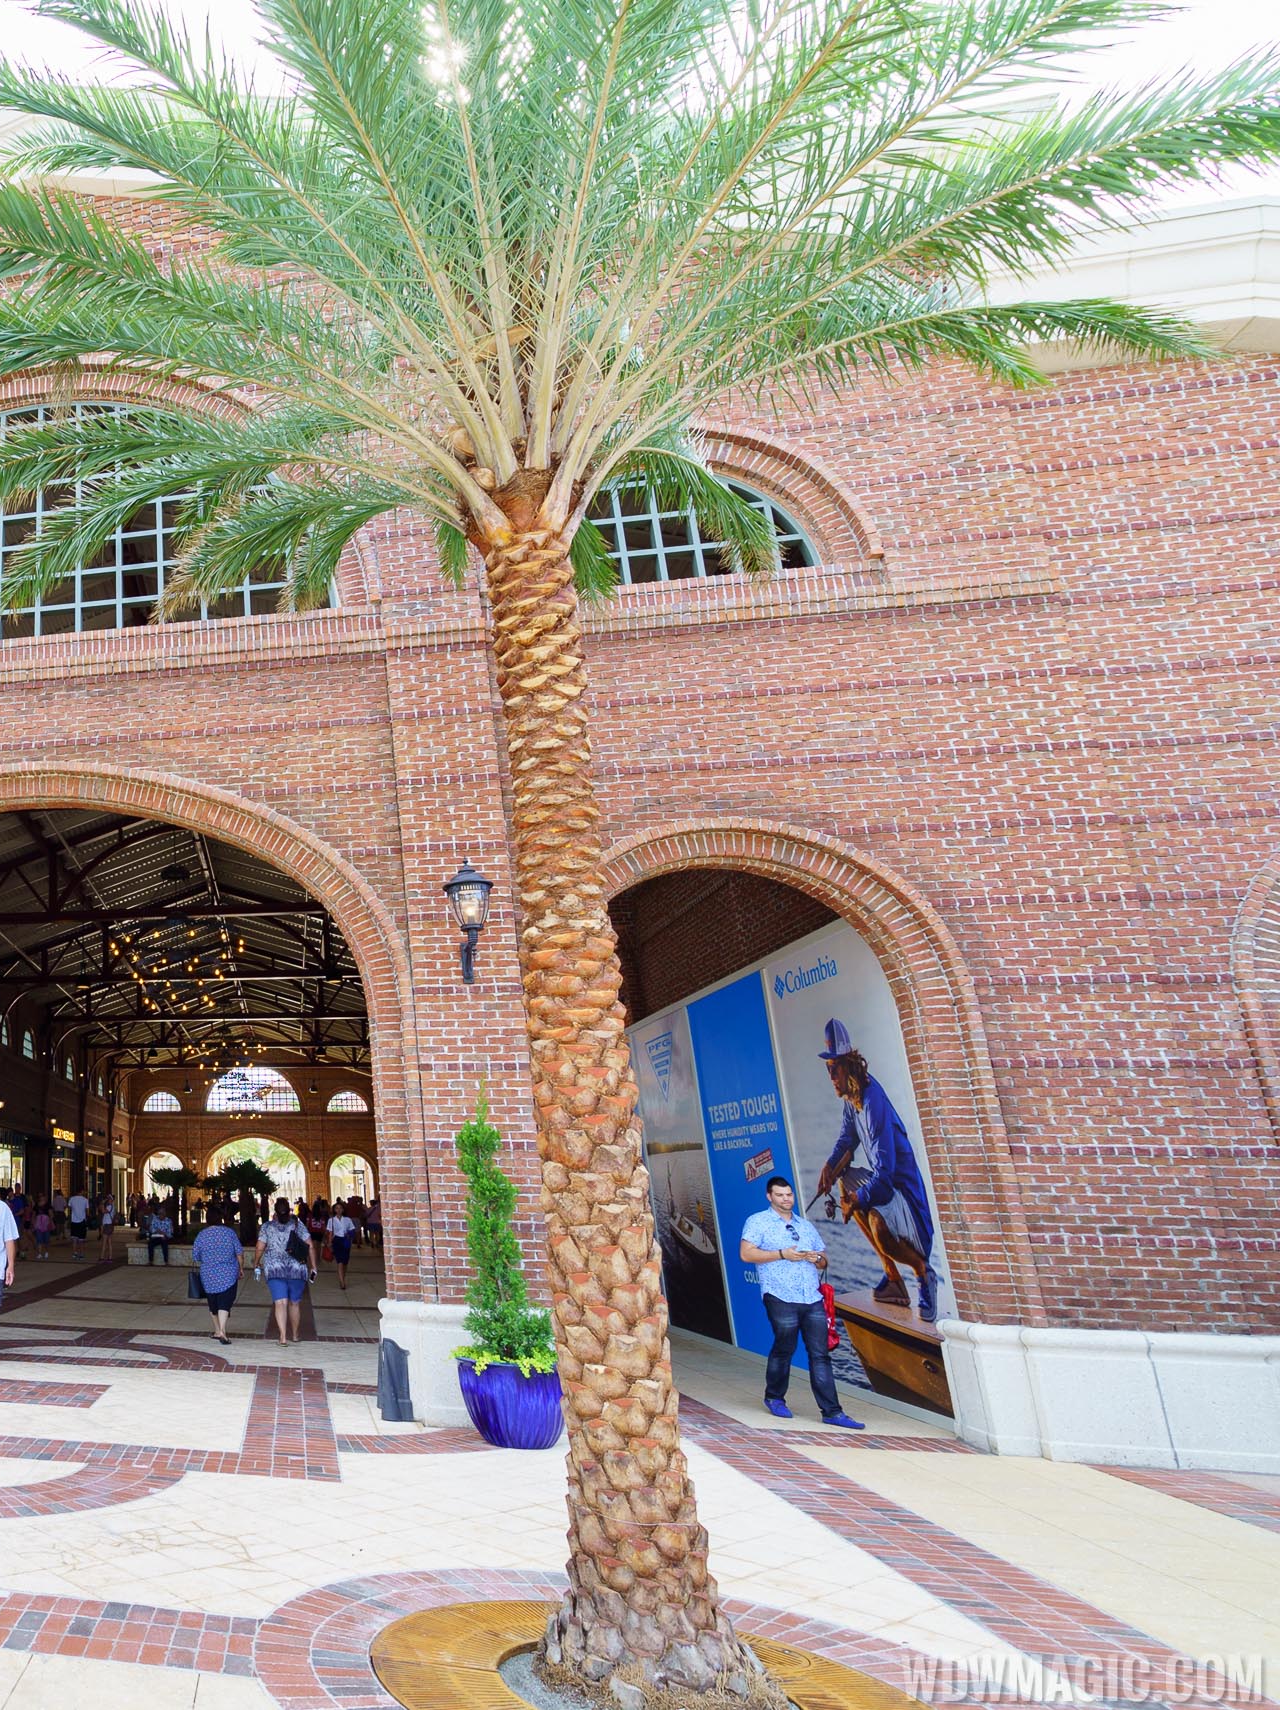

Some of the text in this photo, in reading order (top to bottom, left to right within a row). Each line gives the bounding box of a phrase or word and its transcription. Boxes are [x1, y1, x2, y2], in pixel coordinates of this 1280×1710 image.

[785, 955, 837, 993] Columbia
[648, 1039, 672, 1053] PFG
[708, 1093, 777, 1123] TESTED TOUGH
[712, 1129, 727, 1139] WHERE
[751, 1123, 766, 1134] WEARS
[767, 1121, 778, 1132] YOU
[714, 1141, 724, 1151] LIKE
[744, 1270, 760, 1284] COLU
